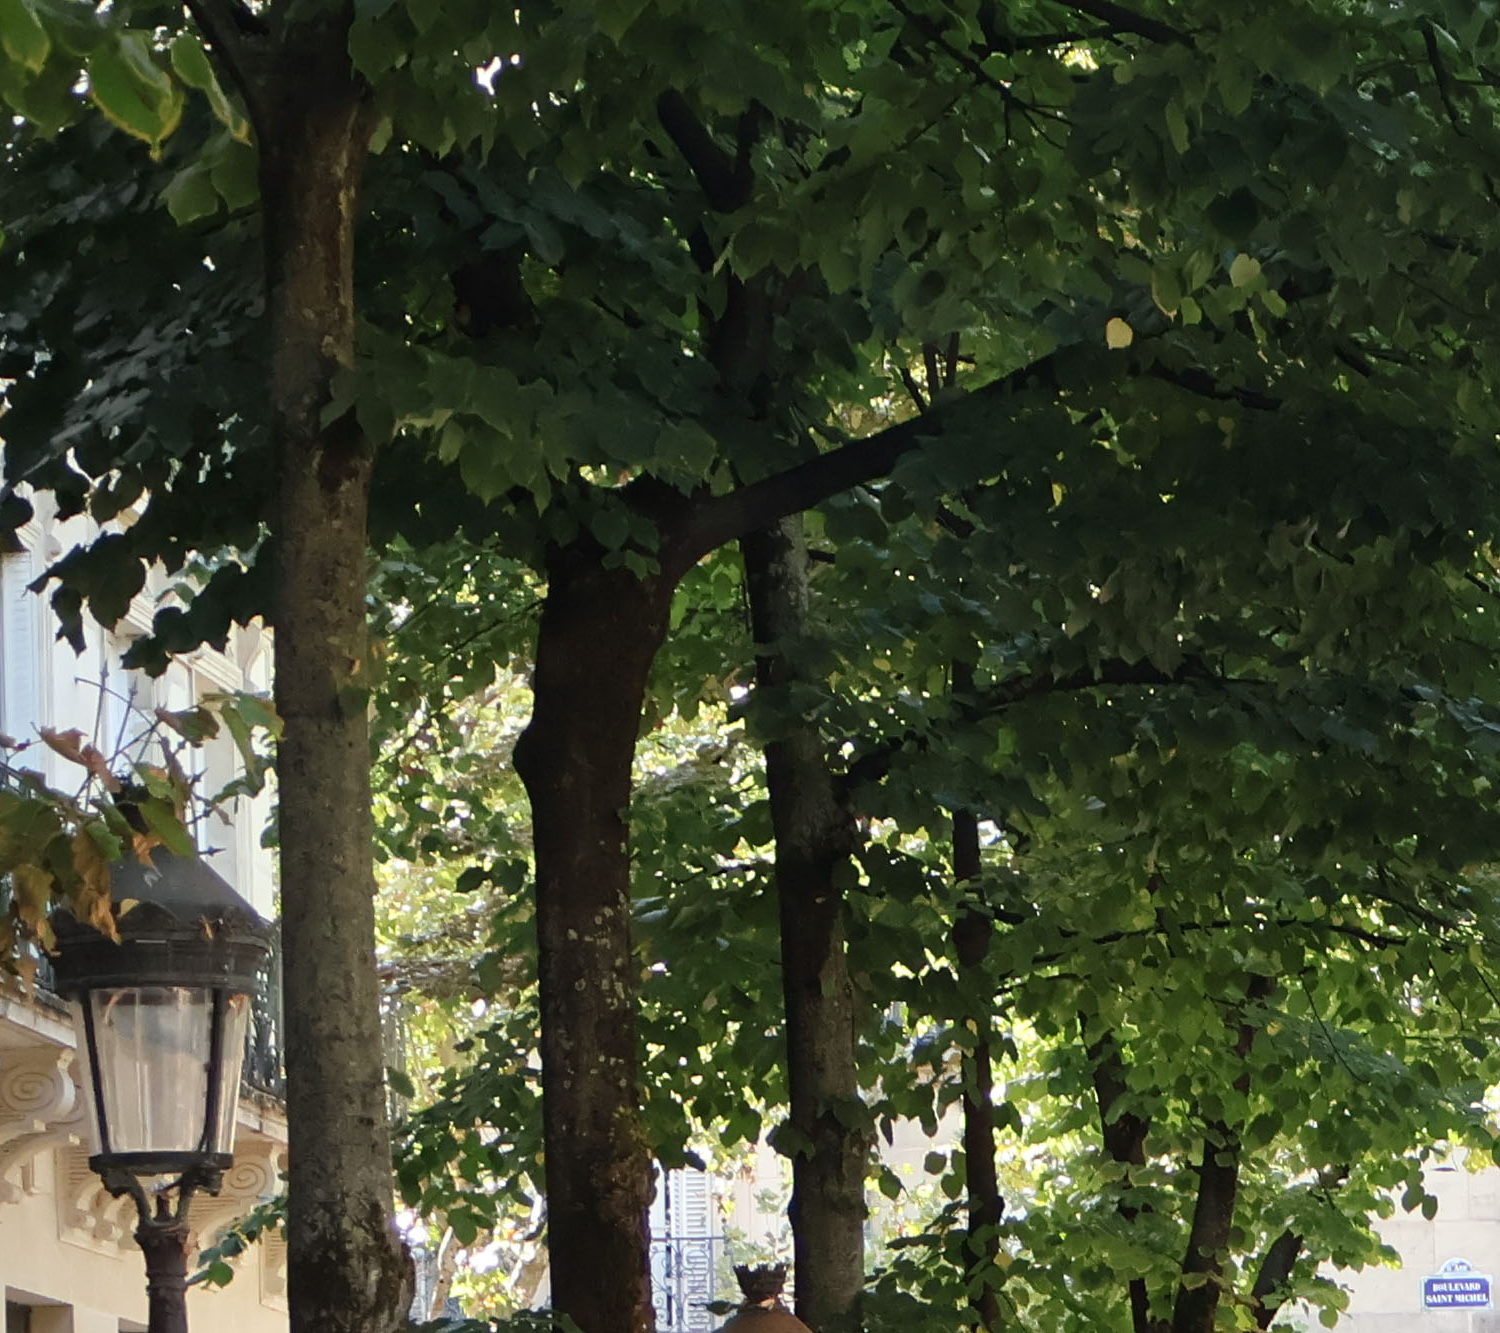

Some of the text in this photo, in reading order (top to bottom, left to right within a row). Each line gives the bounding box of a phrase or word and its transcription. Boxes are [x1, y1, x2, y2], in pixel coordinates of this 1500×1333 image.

[1432, 1282, 1481, 1292] BOULEVARD
[1426, 1292, 1488, 1304] SAINT MICHEL
